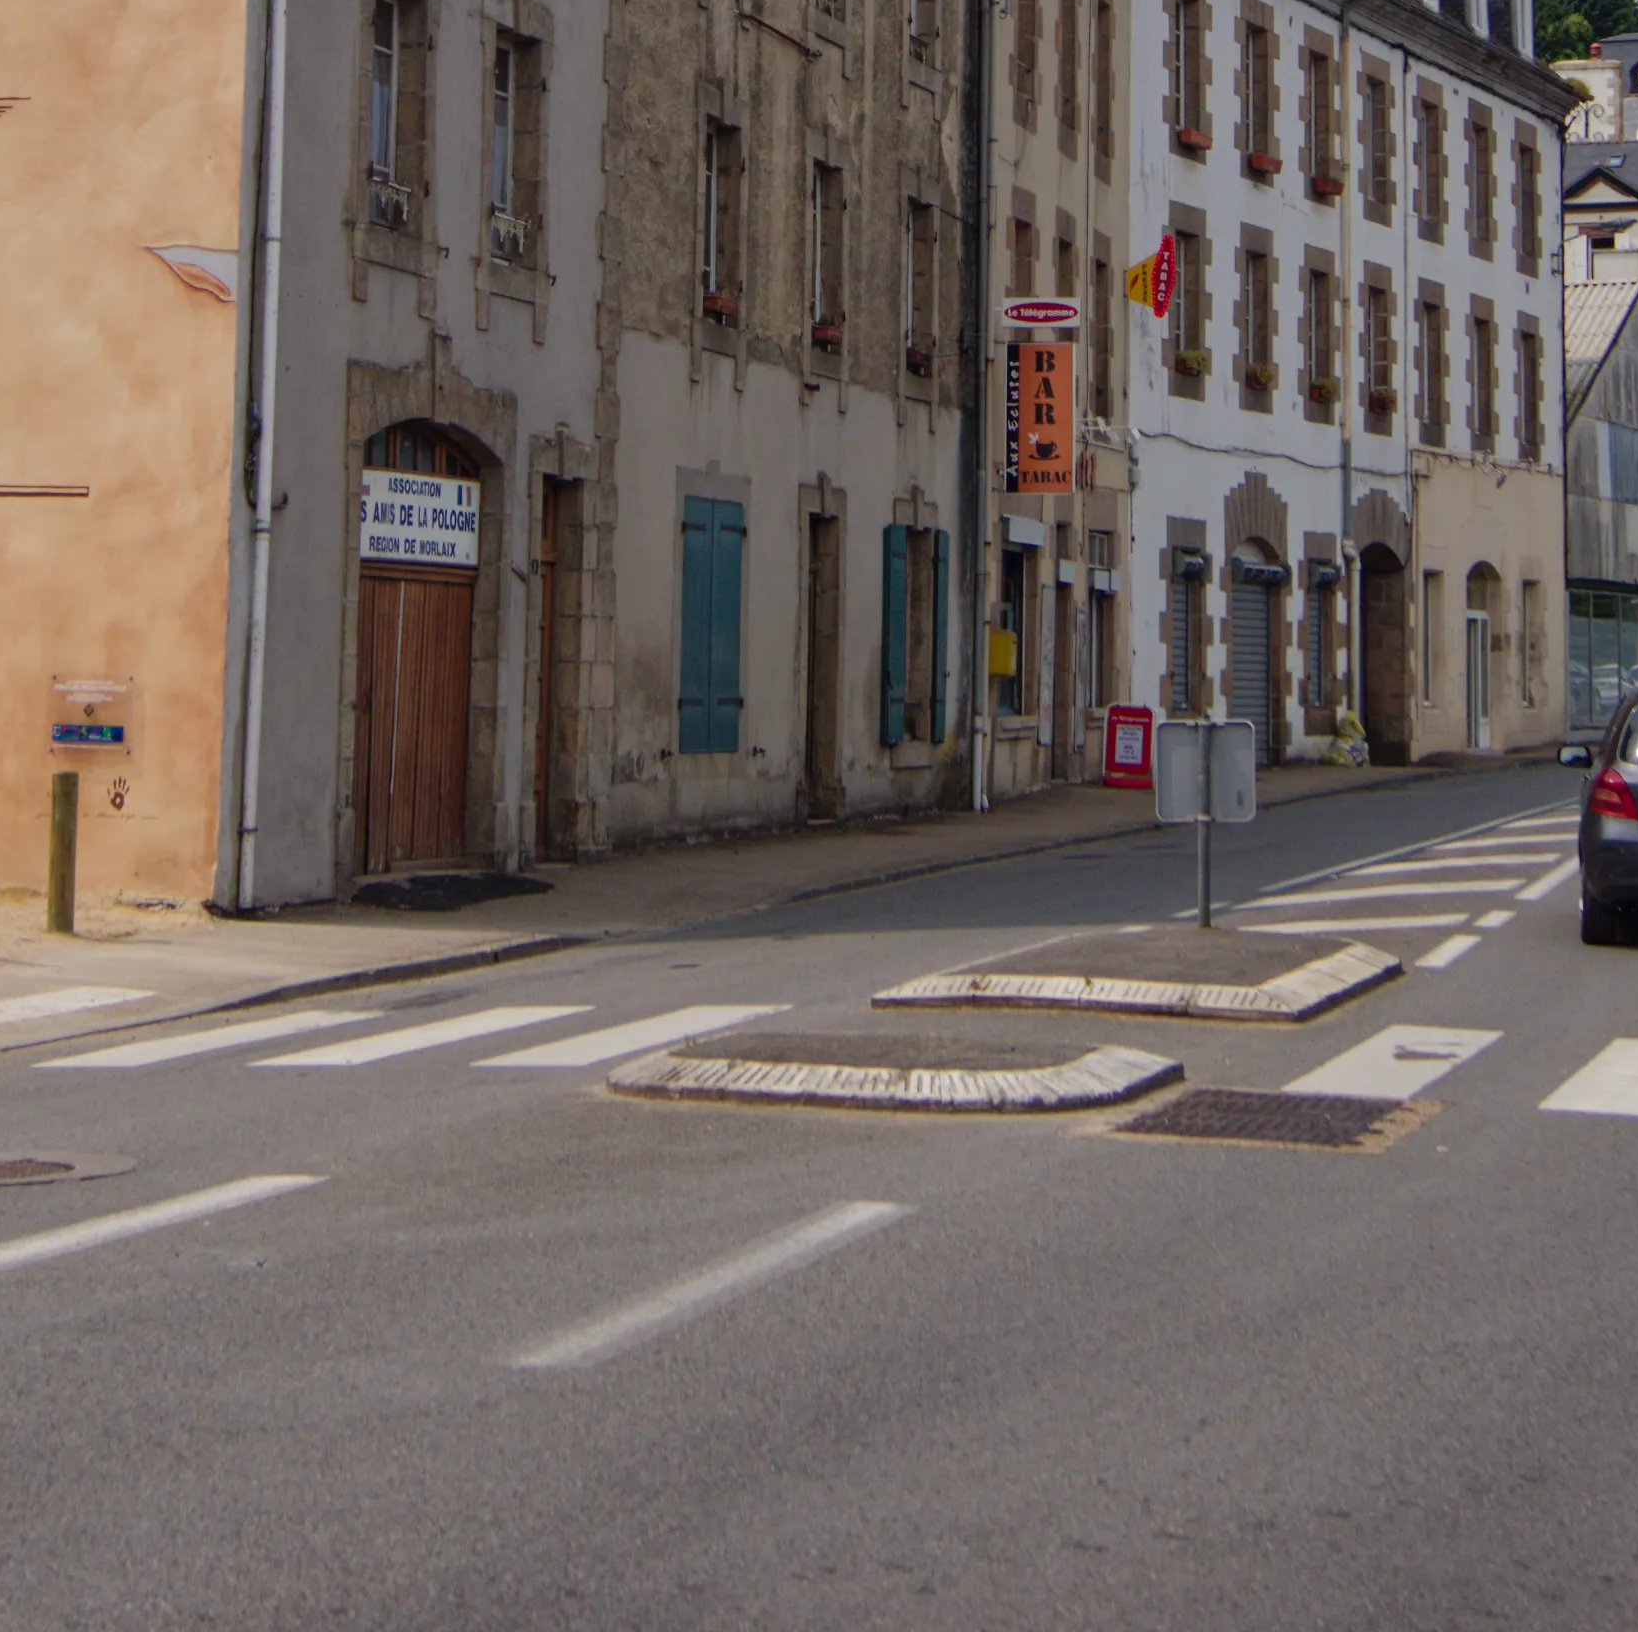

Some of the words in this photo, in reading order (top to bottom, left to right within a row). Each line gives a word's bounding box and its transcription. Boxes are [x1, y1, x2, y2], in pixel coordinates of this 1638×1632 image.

[1157, 251, 1170, 302] TABAC
[1008, 308, 1018, 317] Le
[1034, 351, 1056, 425] BAR
[1007, 441, 1018, 477] Aux
[388, 477, 442, 498] ASSOCIATION
[1021, 471, 1072, 484] TABAC
[373, 501, 395, 525] AMIS
[400, 504, 414, 526] DE
[418, 506, 428, 528] LA
[432, 508, 476, 533] POLOGNE
[369, 536, 399, 553] REGION
[404, 539, 416, 554] DE
[419, 540, 456, 557] MORLAIX
